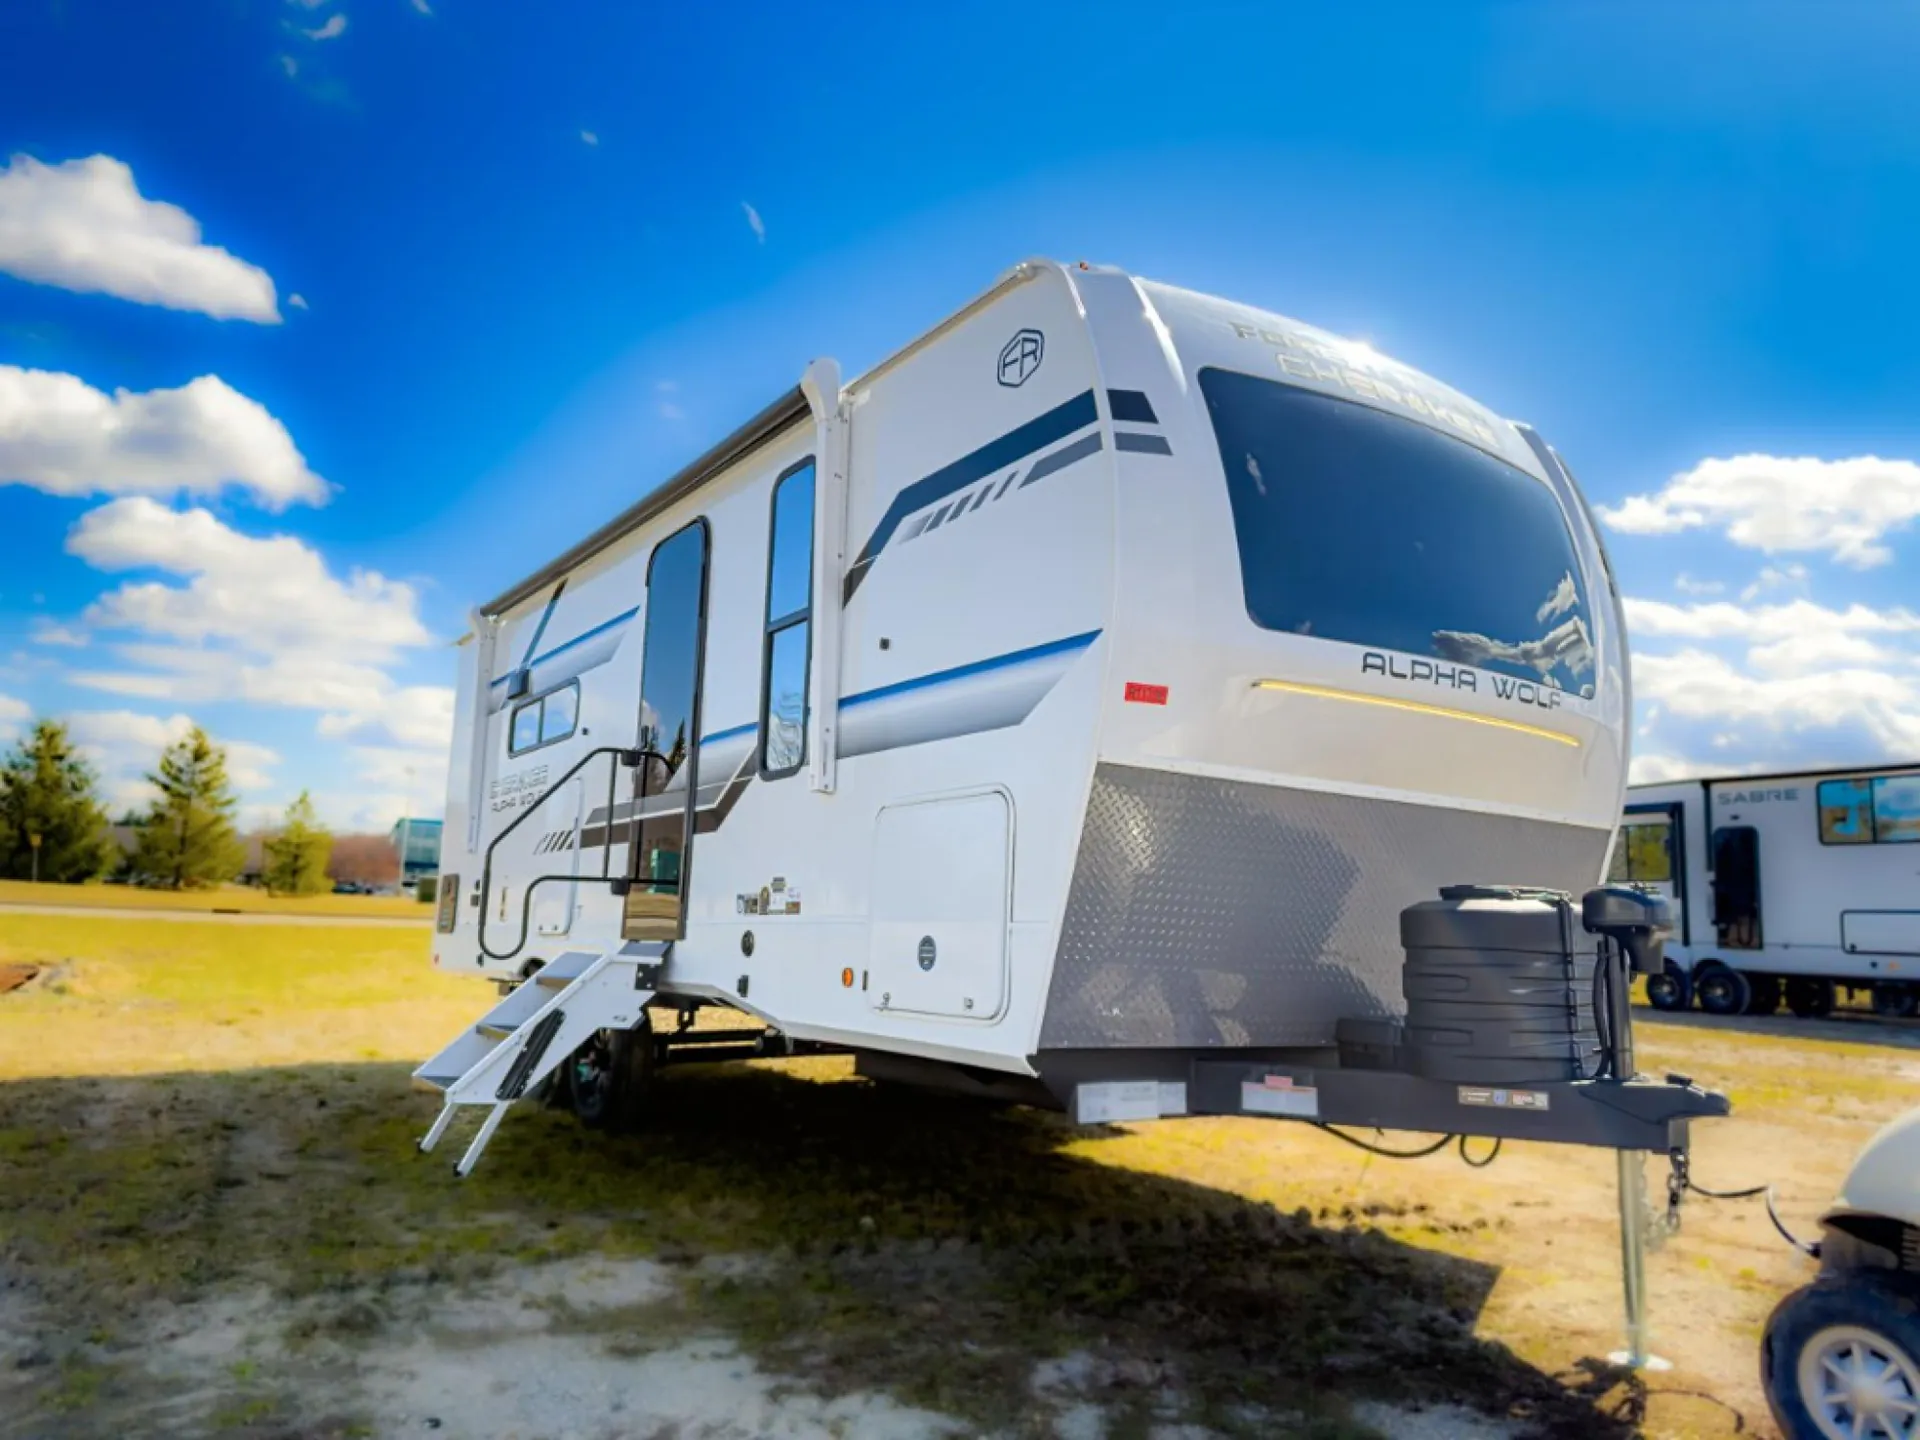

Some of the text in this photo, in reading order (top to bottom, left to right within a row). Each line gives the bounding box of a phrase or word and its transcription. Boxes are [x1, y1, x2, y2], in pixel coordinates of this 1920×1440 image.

[1002, 336, 1041, 379] FR
[1361, 652, 1562, 710] ALPHA WOLF
[1717, 788, 1800, 805] SABRE
